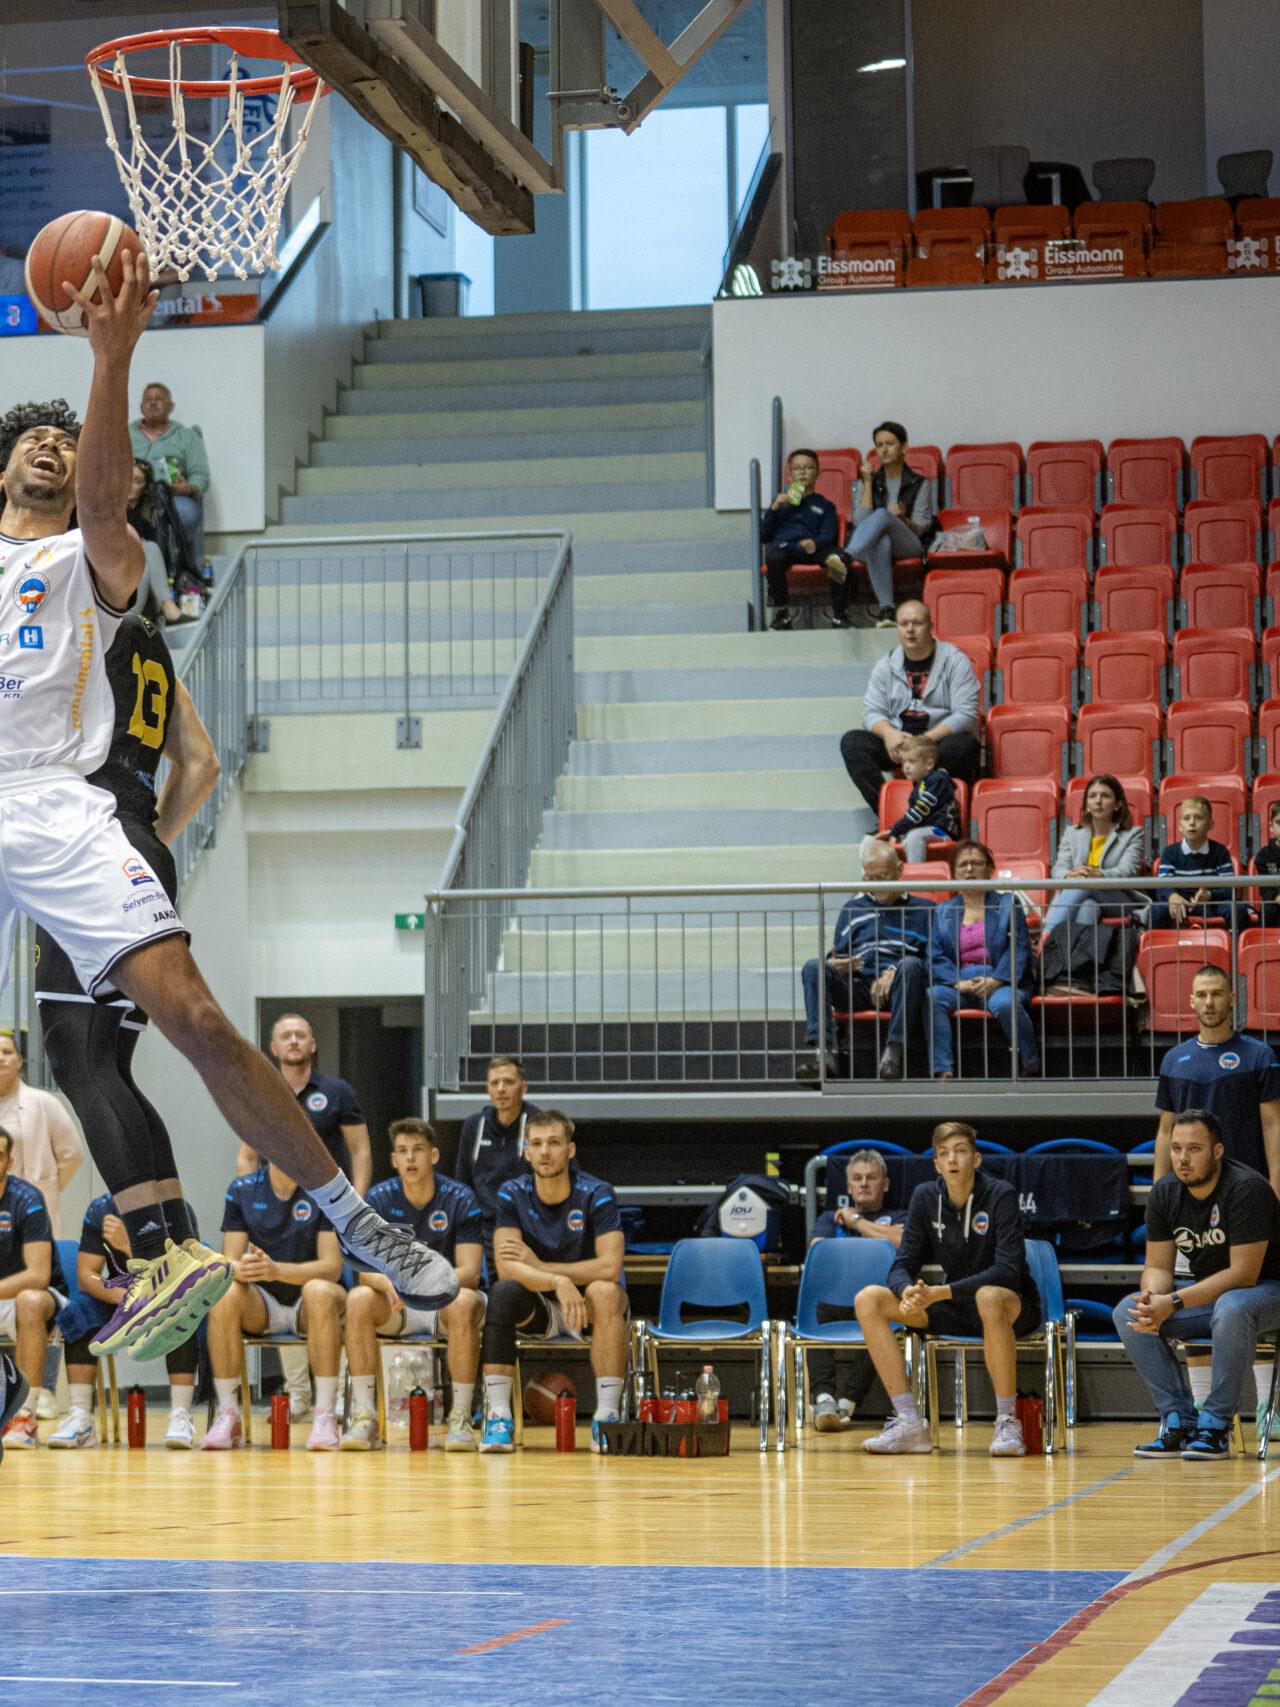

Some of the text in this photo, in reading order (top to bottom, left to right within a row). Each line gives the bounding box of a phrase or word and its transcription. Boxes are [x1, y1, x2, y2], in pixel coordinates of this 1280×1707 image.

[817, 255, 896, 274] Eissmann
[1044, 247, 1124, 265] Eissmann
[1045, 263, 1124, 275] Group Automotive
[818, 273, 896, 286] Group Automotive
[127, 651, 169, 750] 13
[152, 908, 177, 923] JAKO
[1194, 1228, 1226, 1249] JAKO
